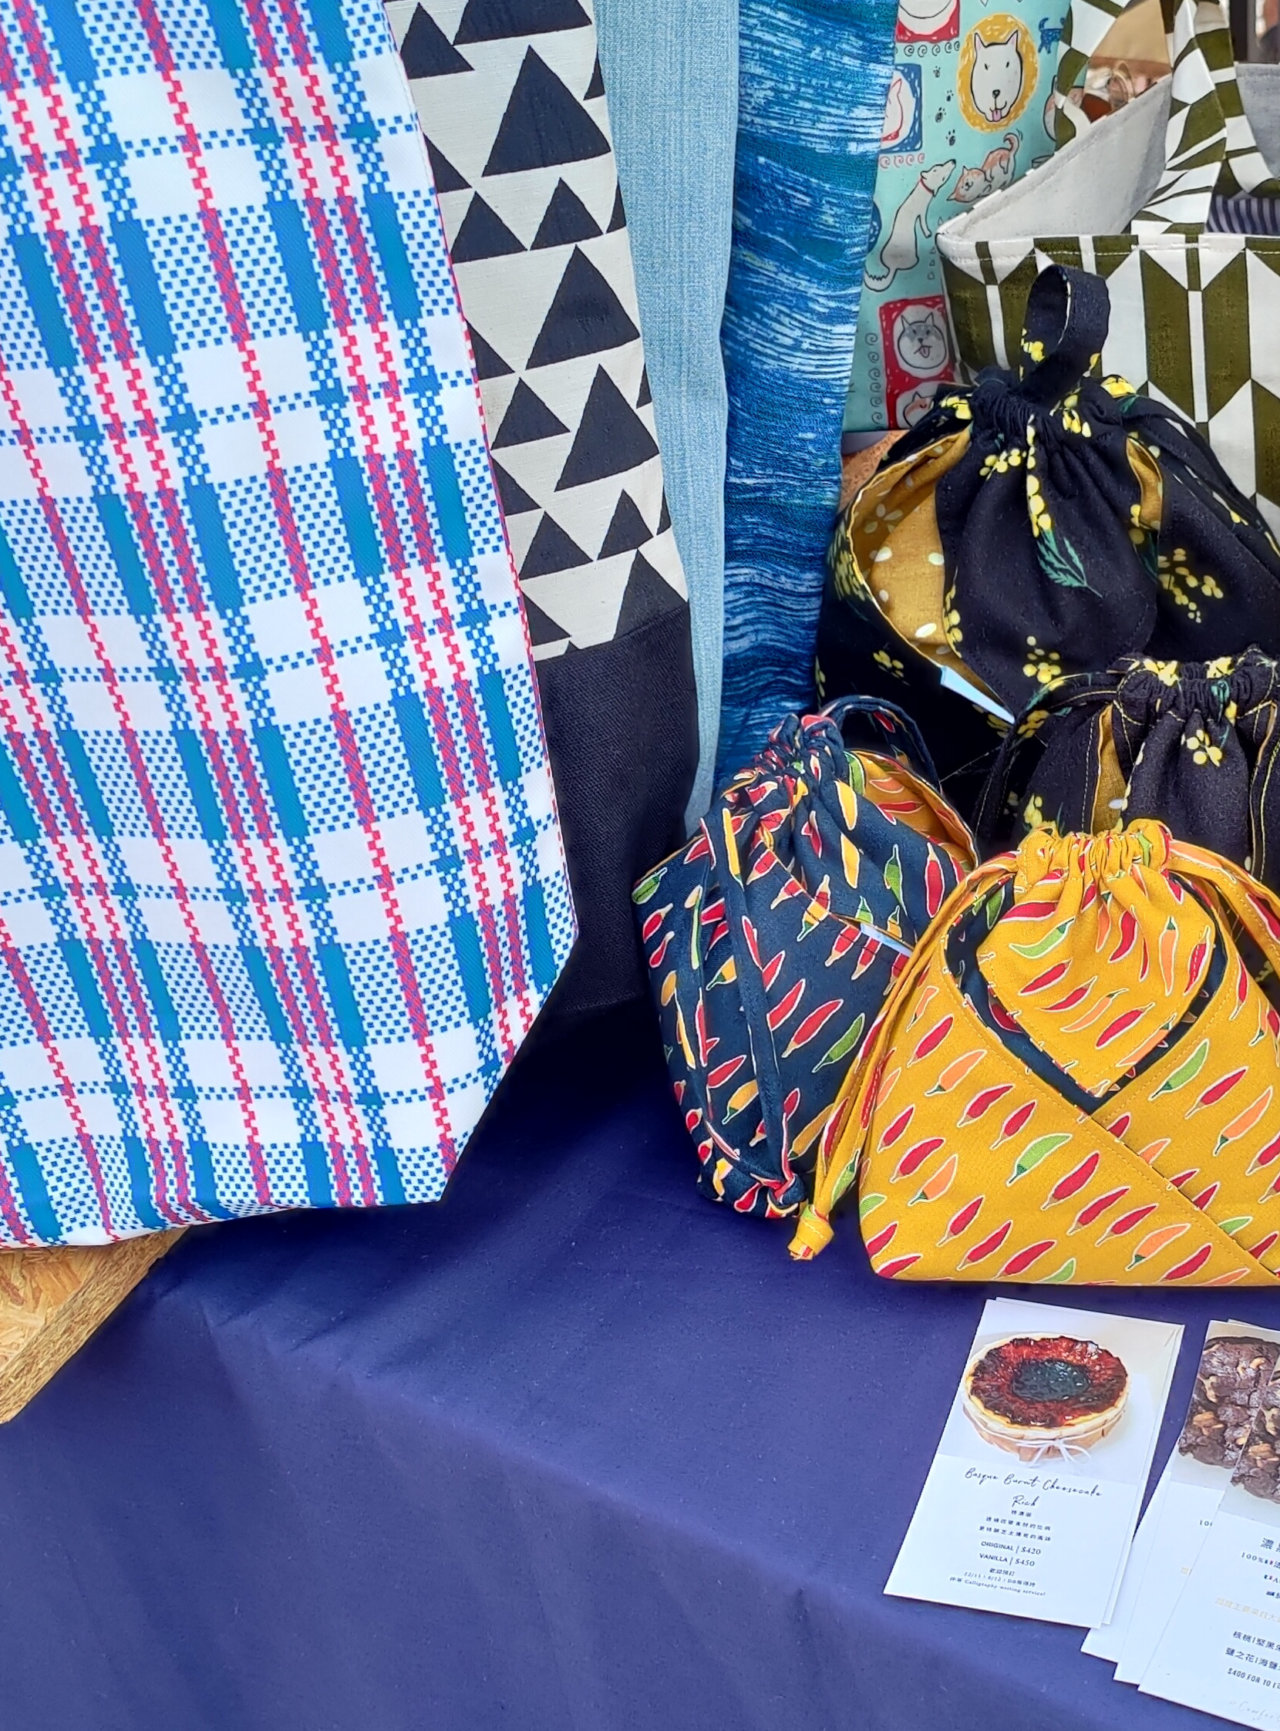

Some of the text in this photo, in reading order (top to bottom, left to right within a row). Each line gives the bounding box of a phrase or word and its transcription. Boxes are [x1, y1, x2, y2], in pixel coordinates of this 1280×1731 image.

[981, 1541, 1014, 1551] ORIGINAL
[1021, 1546, 1042, 1555] $420
[979, 1553, 1008, 1562] VANILLA
[1015, 1558, 1035, 1567] $450
